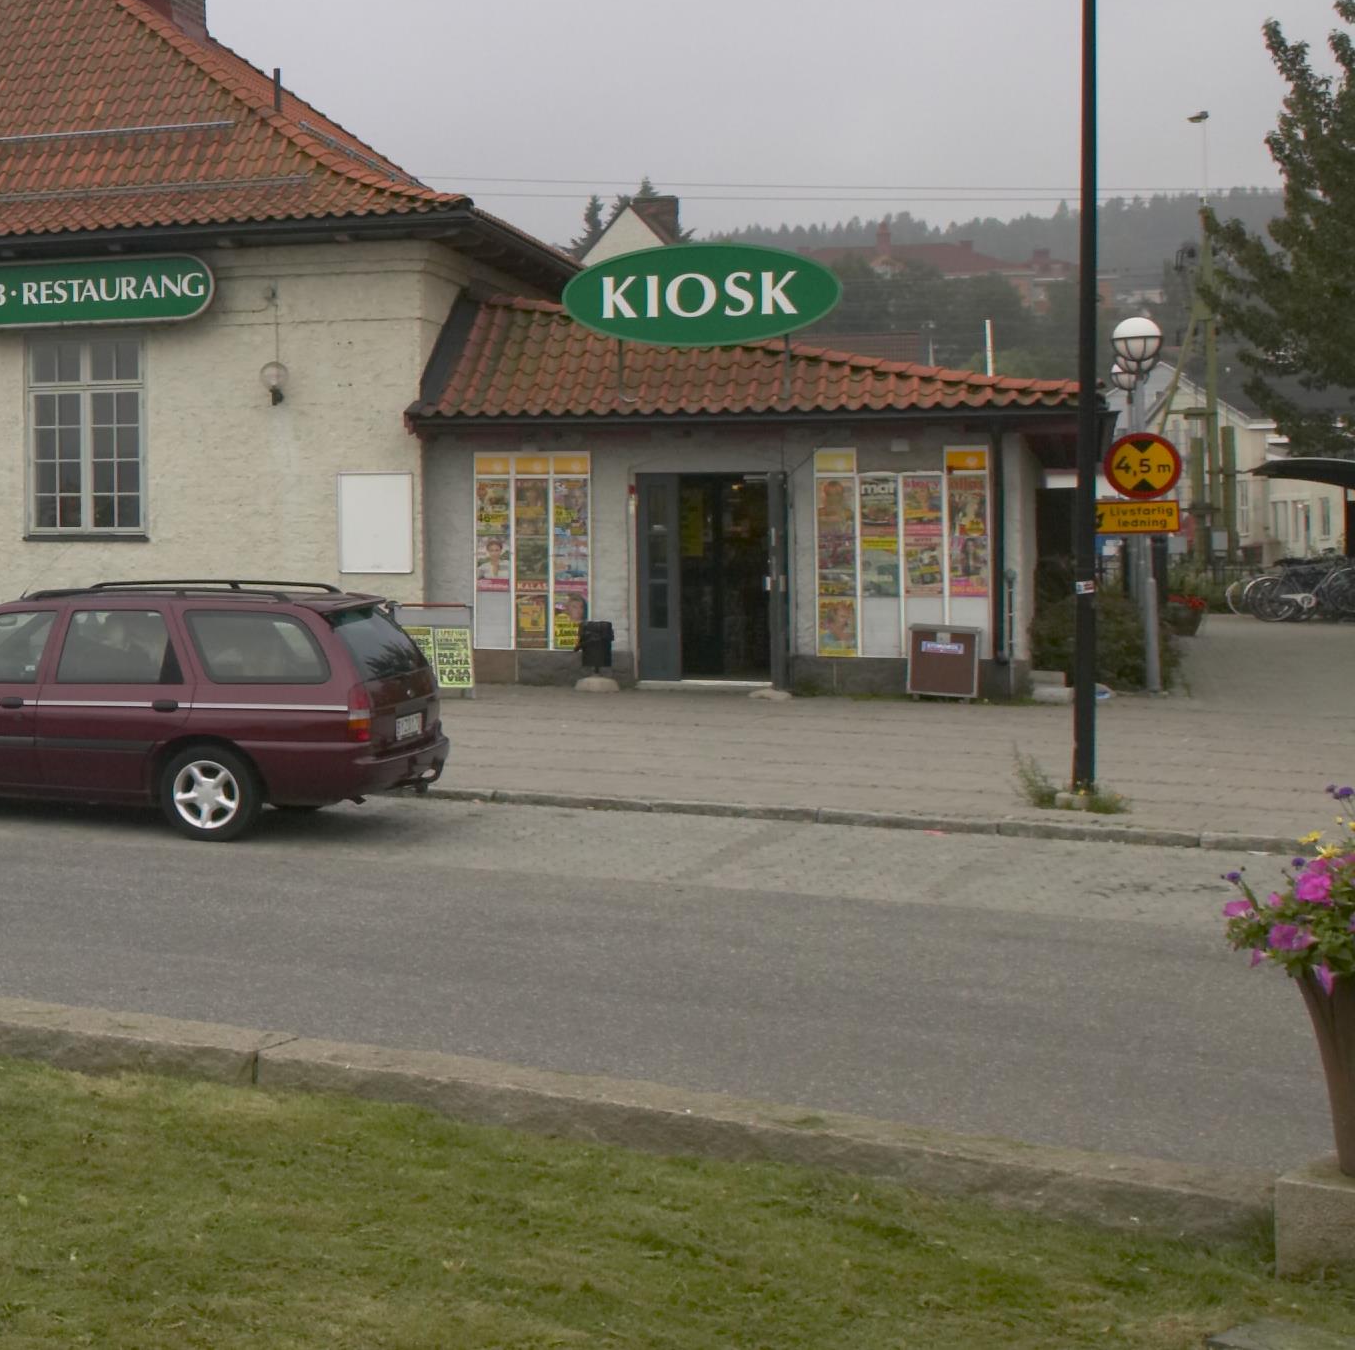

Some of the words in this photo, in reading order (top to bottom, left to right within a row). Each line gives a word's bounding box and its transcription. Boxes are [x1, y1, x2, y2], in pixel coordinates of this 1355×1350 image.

[21, 272, 205, 305] RESTAURANG
[601, 270, 799, 319] KIOSK
[1114, 456, 1152, 477] 4,5
[1156, 463, 1172, 474] m
[861, 482, 896, 495] mat
[1109, 506, 1174, 517] Livsfarlig
[1117, 518, 1168, 529] ledning
